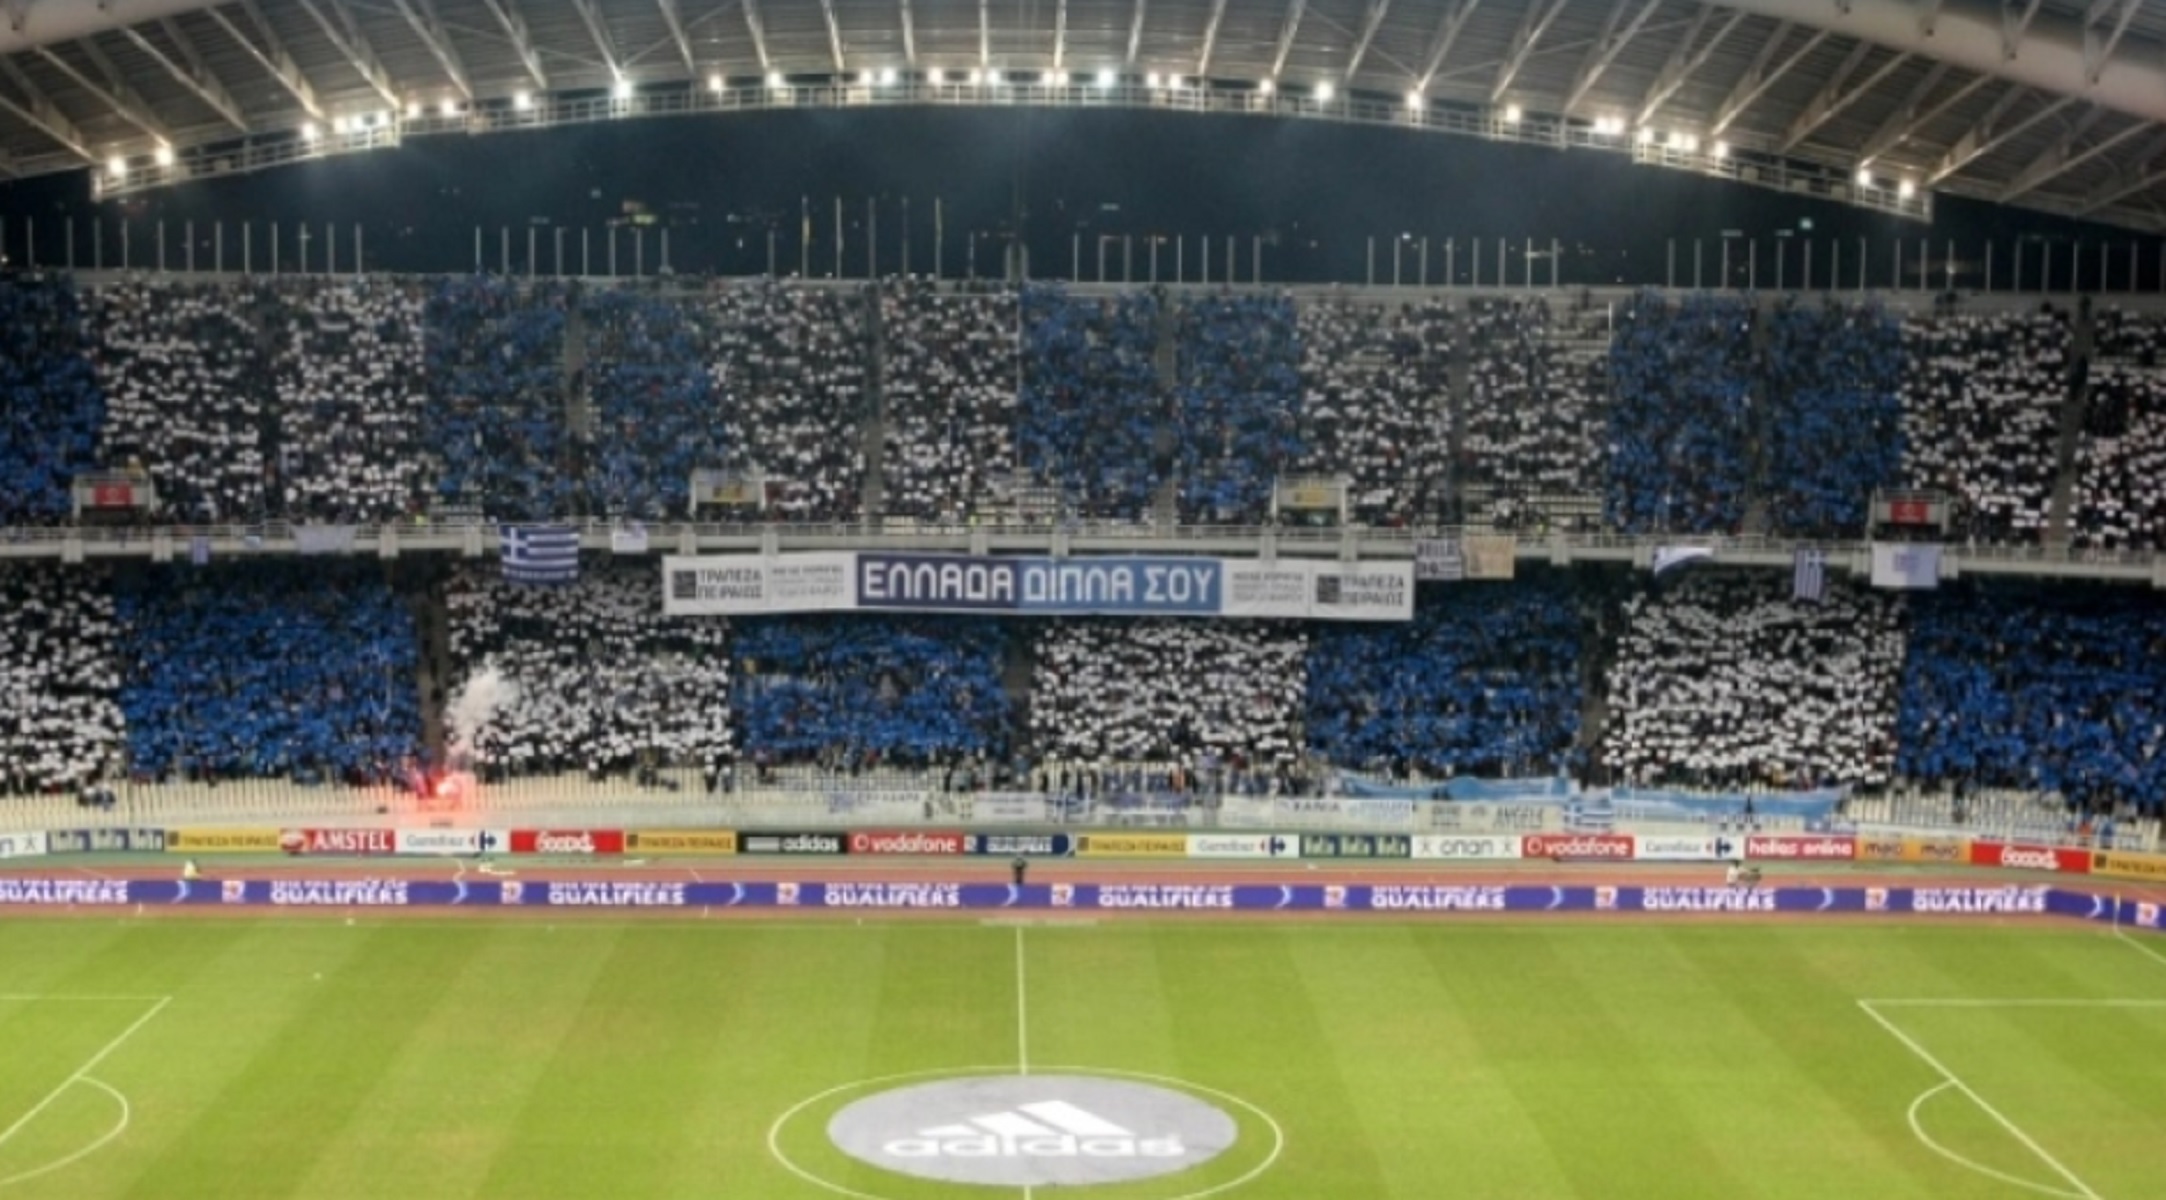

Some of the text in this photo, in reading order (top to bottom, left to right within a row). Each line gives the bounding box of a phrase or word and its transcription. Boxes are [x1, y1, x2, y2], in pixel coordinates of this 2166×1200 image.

[864, 561, 1214, 603] ΕΛΛΑΔΑ ΔΙΠΛΑ ΣΟΥ
[312, 829, 391, 851] AMSTEL
[782, 834, 841, 852] adidas
[871, 832, 958, 852] vodafone
[1543, 835, 1629, 855] vodafone
[1802, 838, 1853, 857] online
[270, 888, 408, 905] QUALIFIERS
[548, 889, 685, 905] QUALIFIERS
[824, 889, 960, 906] QUALIFIERS
[1098, 892, 1233, 907] QUALIFIERS
[1370, 892, 1506, 909] QUALIFIERS
[1642, 893, 1775, 910] QUALIFIERS
[1912, 894, 2046, 912] QUALIFIERS
[882, 1131, 1186, 1158] adidas
